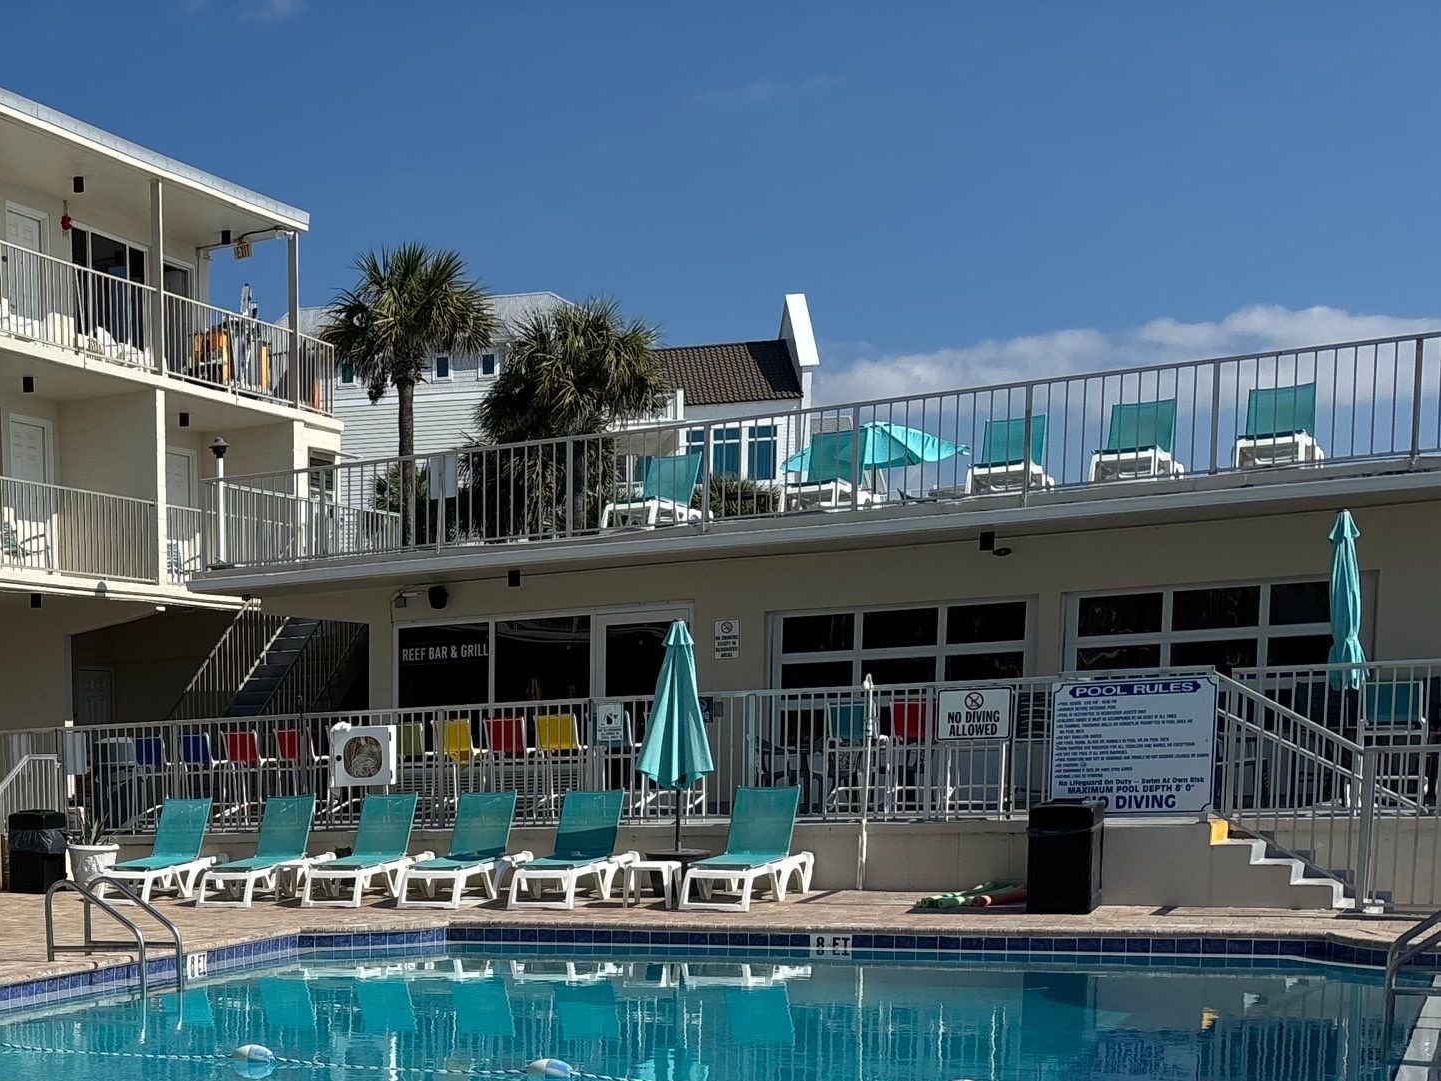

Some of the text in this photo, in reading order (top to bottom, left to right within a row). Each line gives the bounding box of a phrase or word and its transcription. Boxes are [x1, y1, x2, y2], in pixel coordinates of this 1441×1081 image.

[402, 643, 489, 661] REEF BAR & GRILL
[1075, 682, 1194, 697] POOL RULES
[948, 710, 1000, 724] NO DIVING
[949, 723, 998, 736] ALLOWED
[1068, 786, 1114, 794] MAXIMUM
[1116, 785, 1140, 793] POOL
[1142, 784, 1174, 792] DEPTH
[1070, 779, 1102, 787] Lifeguard
[1115, 794, 1176, 810] DIVING
[816, 936, 824, 948] 8
